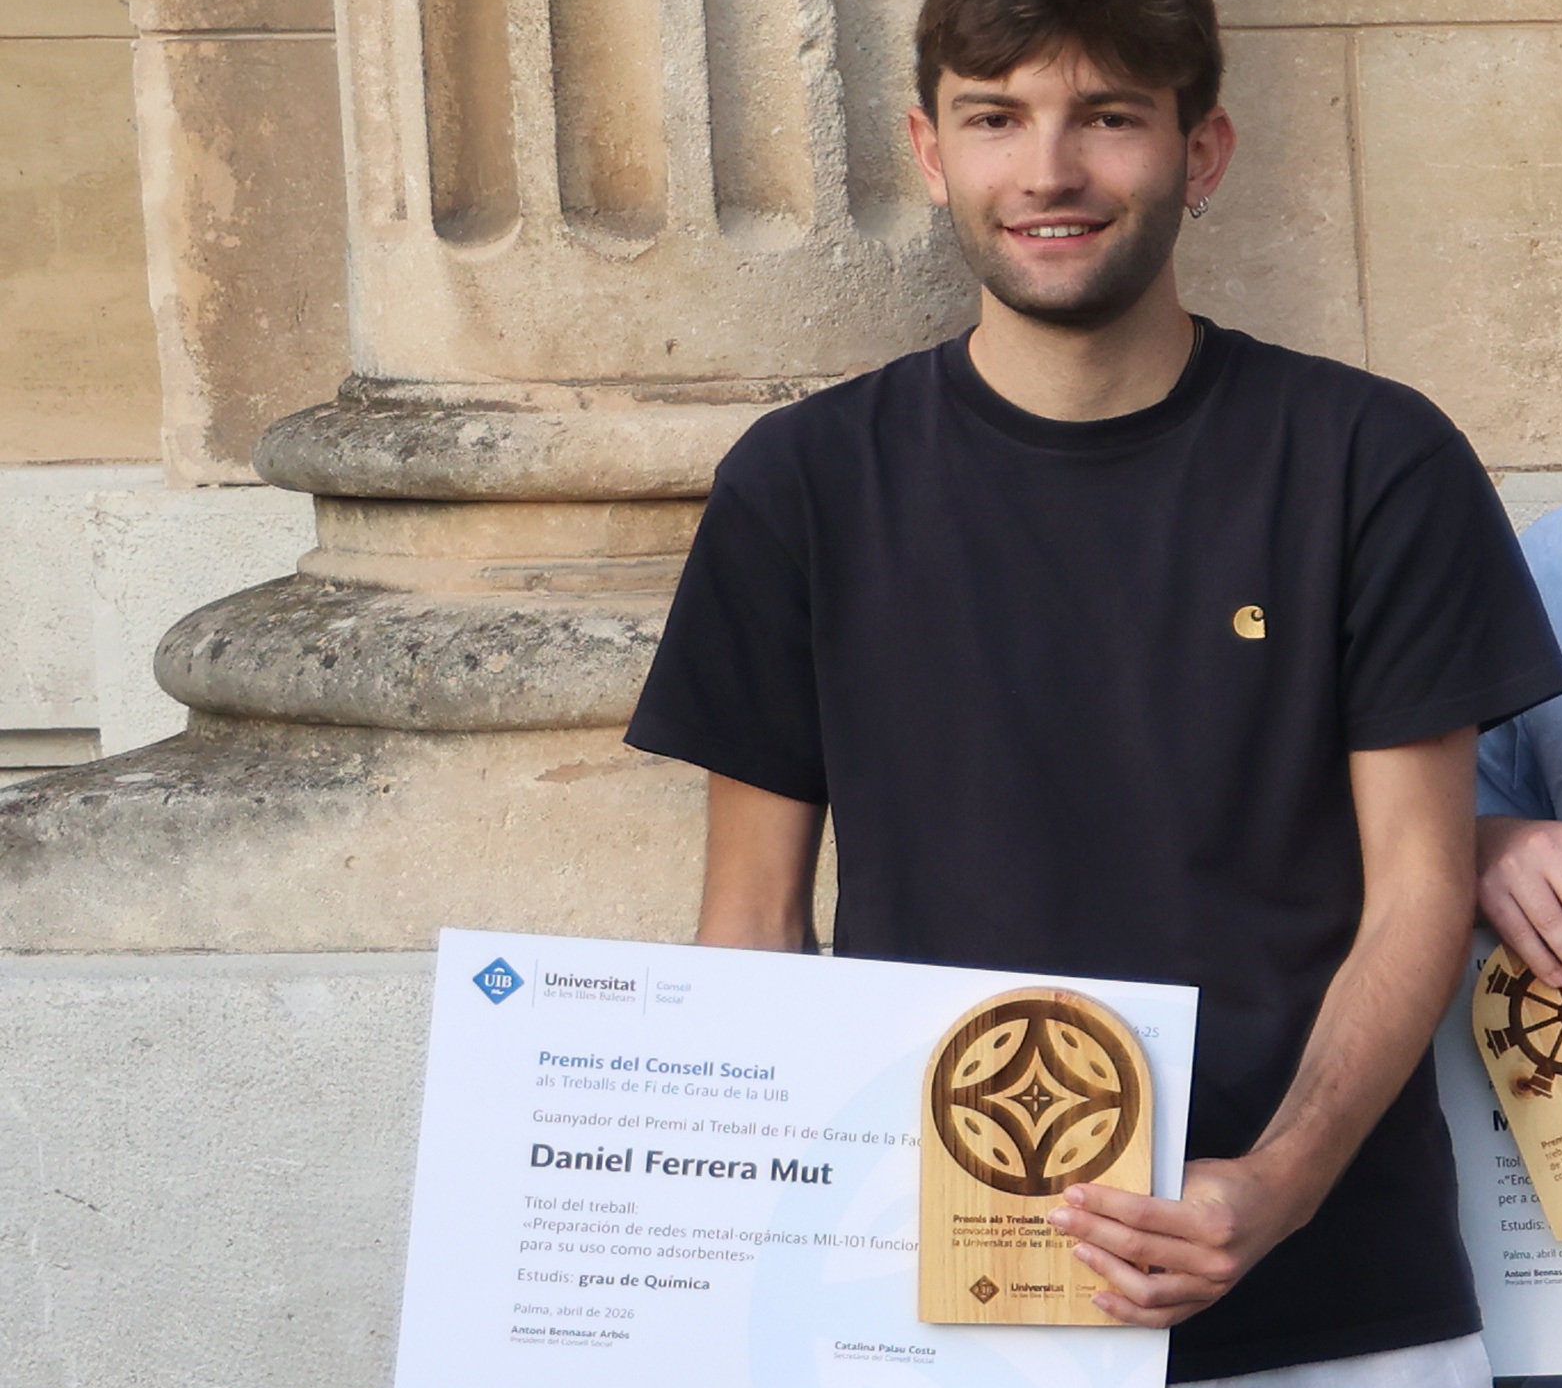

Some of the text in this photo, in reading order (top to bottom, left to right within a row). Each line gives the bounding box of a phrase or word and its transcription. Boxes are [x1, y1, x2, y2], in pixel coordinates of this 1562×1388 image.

[484, 973, 512, 990] UIB
[544, 972, 636, 992] Universitat
[538, 1050, 775, 1081] Premis del Consell Social
[530, 1143, 833, 1185] Daniel Ferrera Mut
[517, 1267, 710, 1290] Estudis: grau de Química
